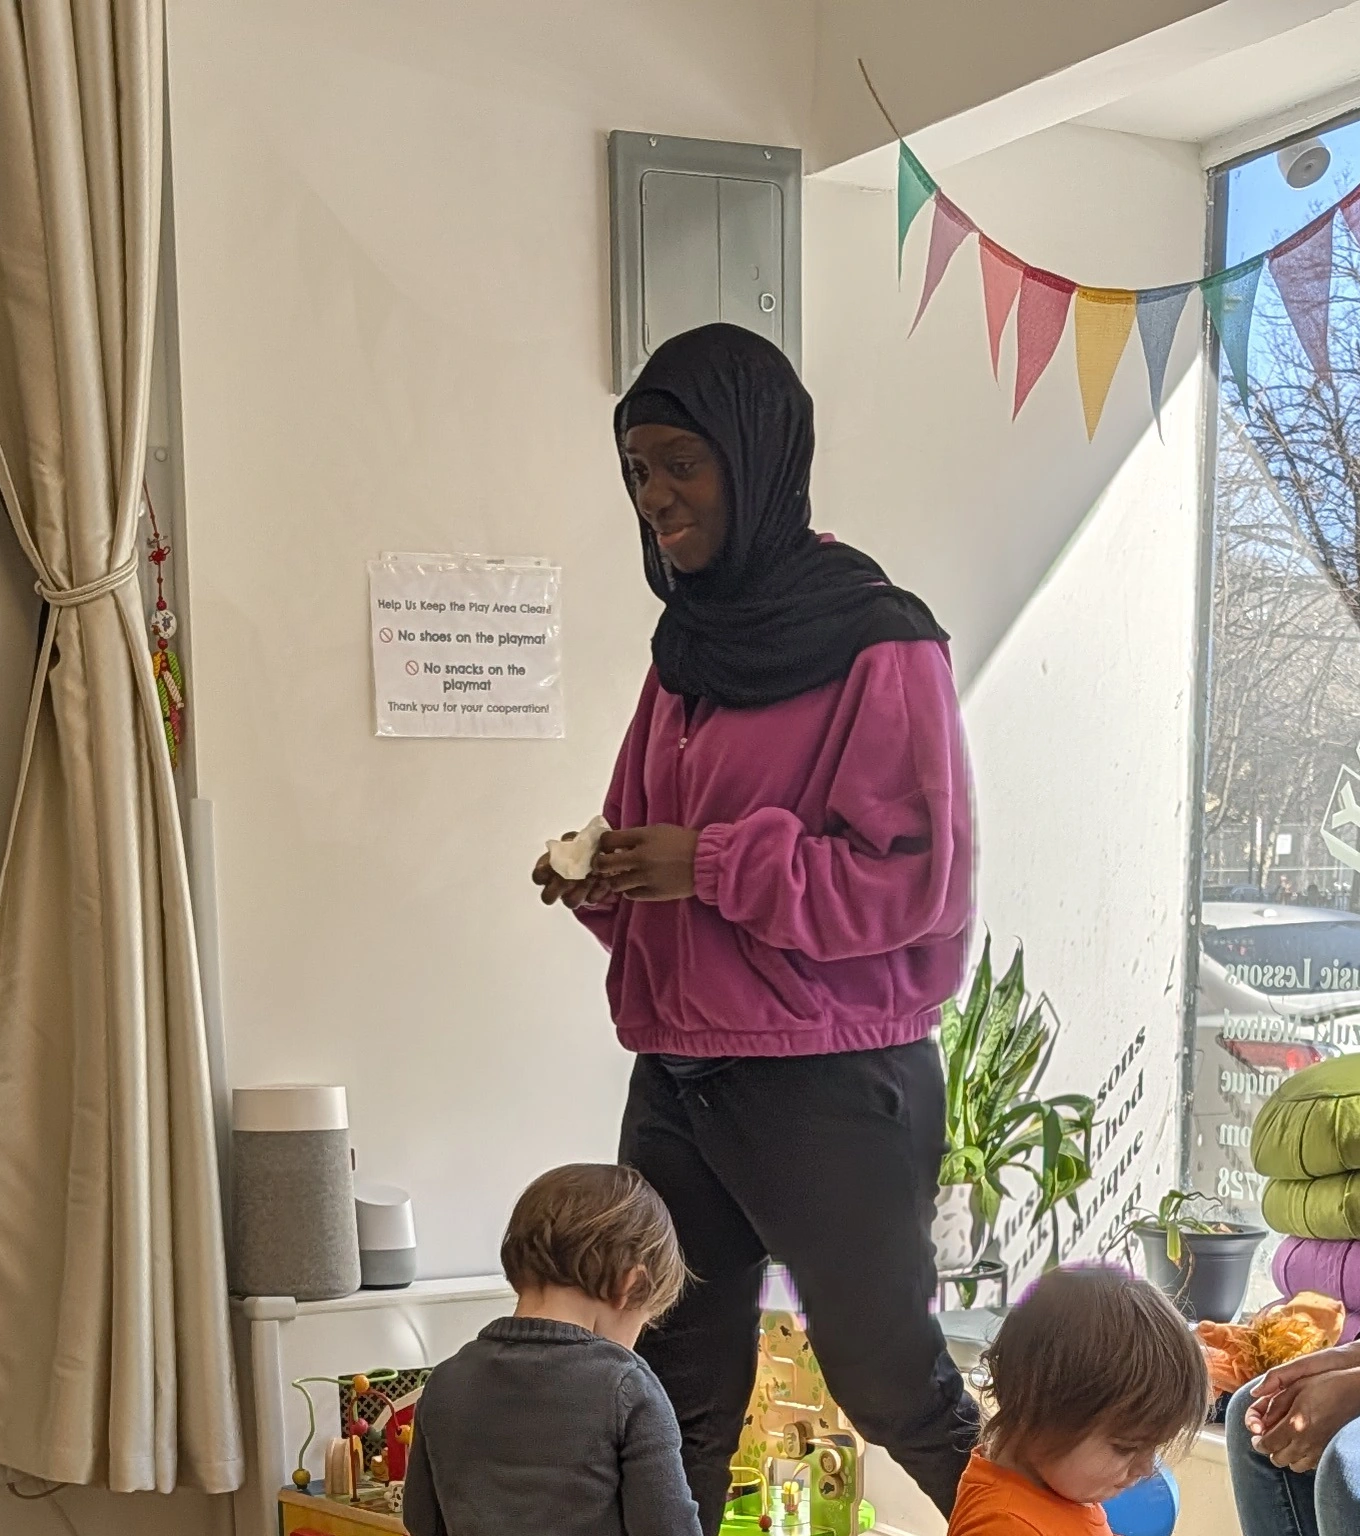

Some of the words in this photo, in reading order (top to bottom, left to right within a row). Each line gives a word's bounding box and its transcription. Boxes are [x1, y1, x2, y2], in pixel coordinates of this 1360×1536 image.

[378, 599, 401, 611] Help
[405, 600, 417, 610] Us
[420, 600, 446, 613] Keep
[450, 601, 465, 611] the
[469, 602, 490, 614] Play
[492, 602, 516, 613] Area
[398, 629, 415, 641] No
[420, 630, 452, 642] shoes
[456, 633, 471, 643] on
[476, 631, 494, 643] the
[498, 632, 546, 647] playmat
[424, 662, 441, 674] No
[445, 662, 484, 675] snacks
[488, 665, 503, 675] on
[507, 664, 526, 675] the
[443, 679, 491, 693] playmat
[388, 701, 417, 712] Thank
[421, 703, 439, 713] you
[443, 701, 457, 712] for
[461, 703, 483, 714] your
[486, 703, 549, 715] cooperation!
